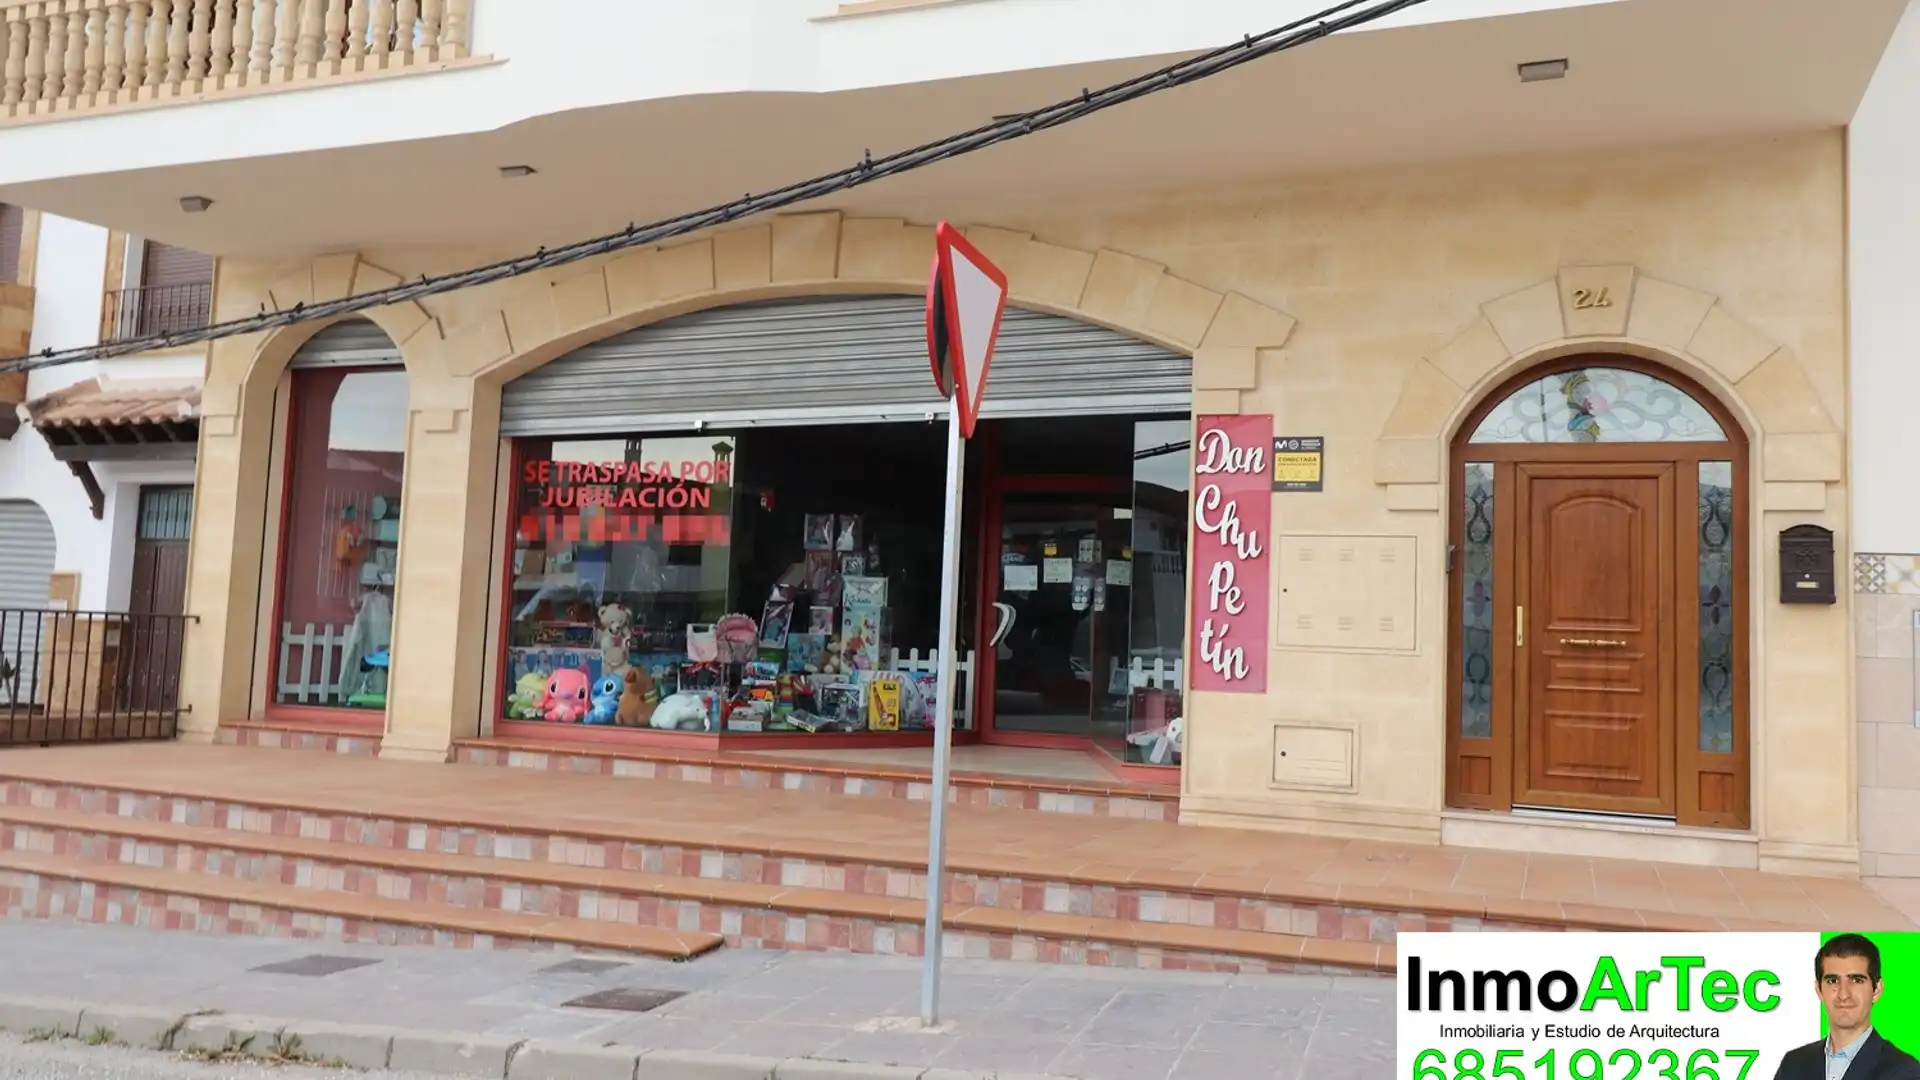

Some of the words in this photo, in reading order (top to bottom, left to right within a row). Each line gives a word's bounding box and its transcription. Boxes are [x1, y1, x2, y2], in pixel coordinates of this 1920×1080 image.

[524, 461, 550, 483] SE
[554, 461, 673, 484] TRASPASA
[680, 461, 730, 484] POR
[1196, 429, 1266, 473] Don
[540, 483, 711, 508] JUBILACIÓN
[1196, 484, 1262, 560] Chu
[1200, 618, 1250, 681] tín
